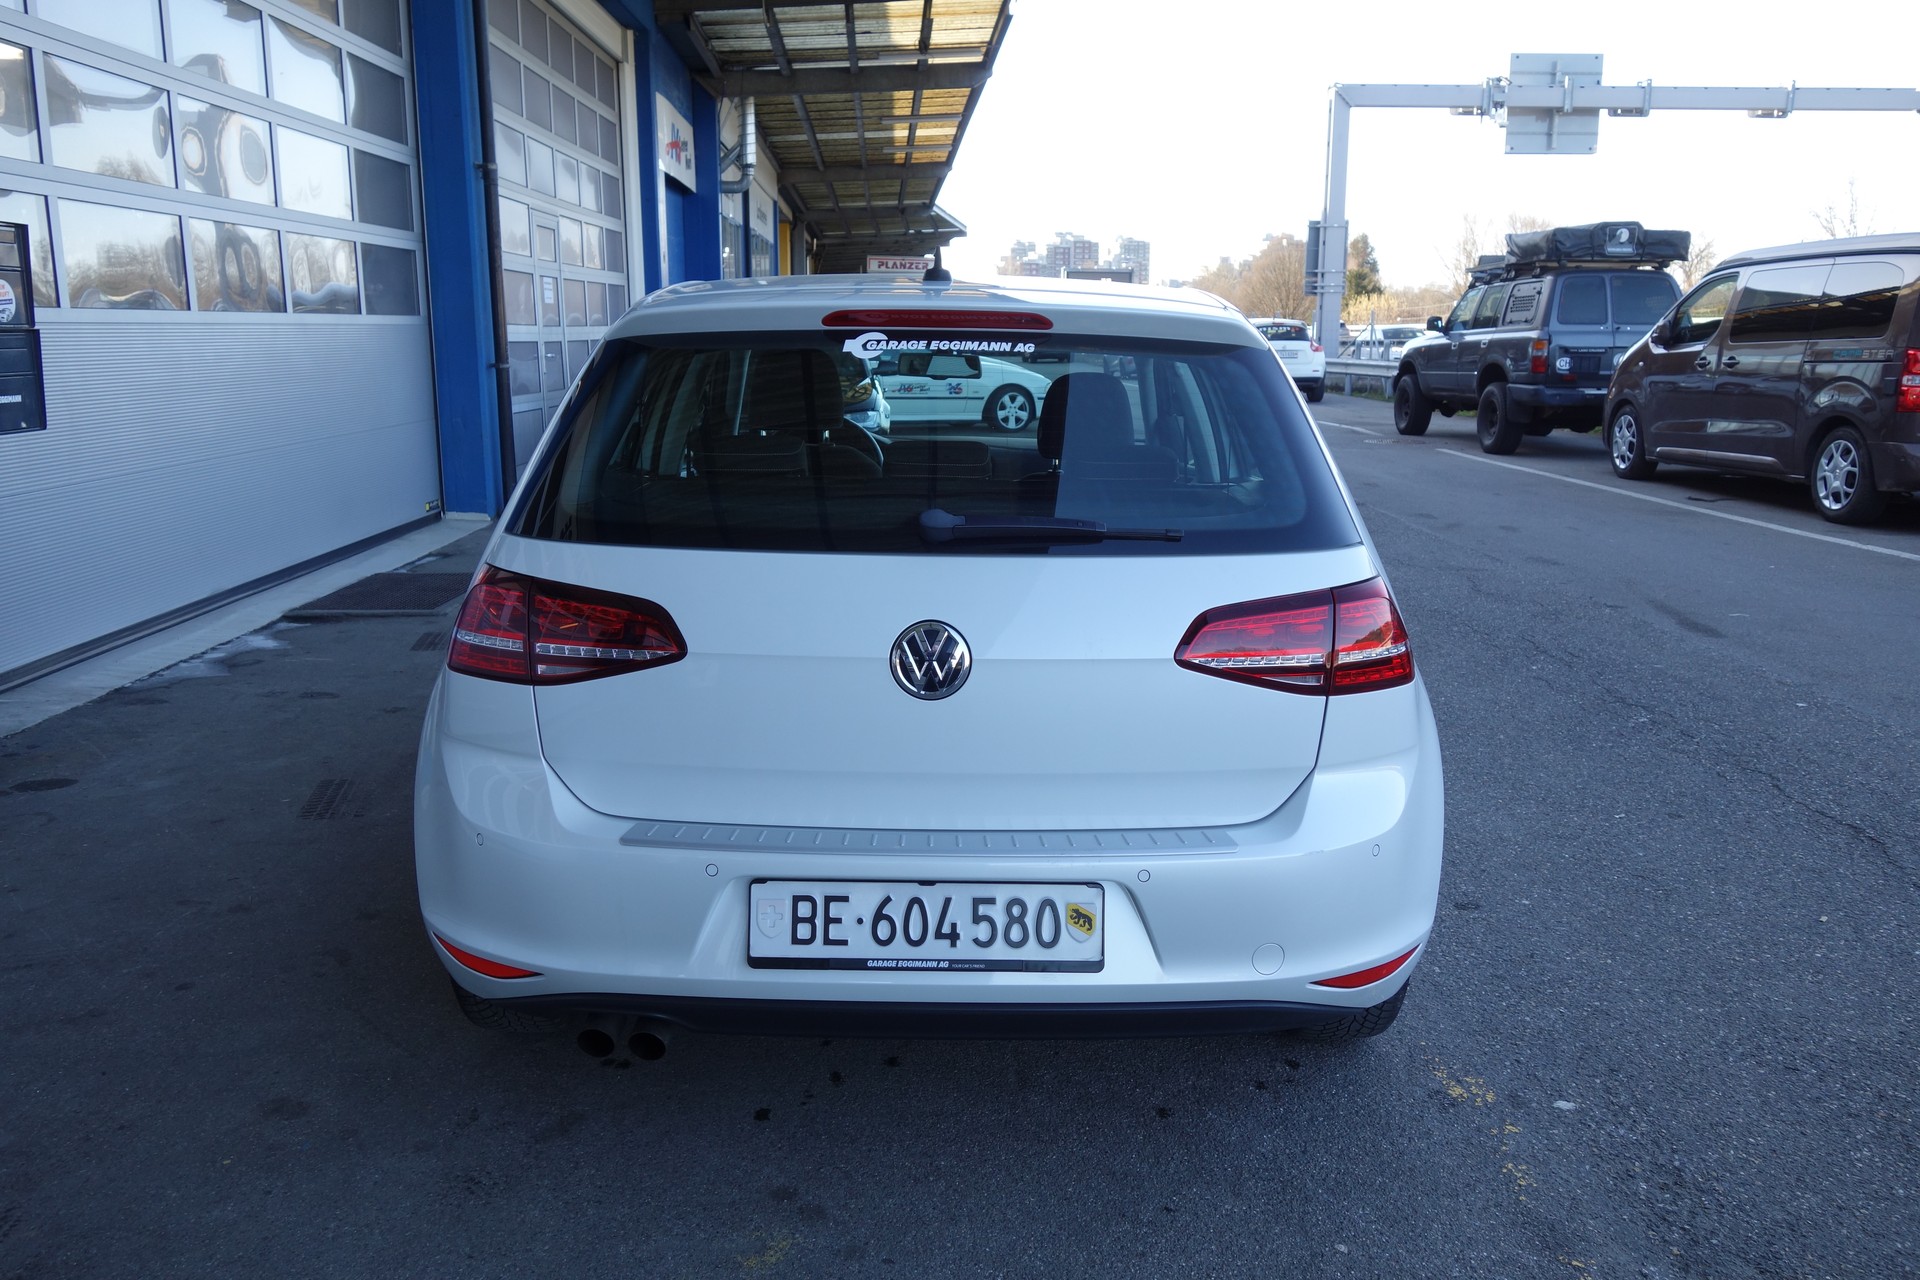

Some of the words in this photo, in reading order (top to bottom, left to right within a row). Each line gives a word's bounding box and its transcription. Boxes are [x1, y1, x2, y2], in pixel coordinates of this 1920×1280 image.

[877, 260, 929, 270] PLANZER
[866, 339, 927, 350] GARAGE
[929, 340, 1012, 352] EGGIMANN
[1013, 342, 1036, 353] AG
[867, 959, 898, 968] GARAGE
[898, 960, 938, 968] EGGIMANN
[938, 960, 950, 968] AG
